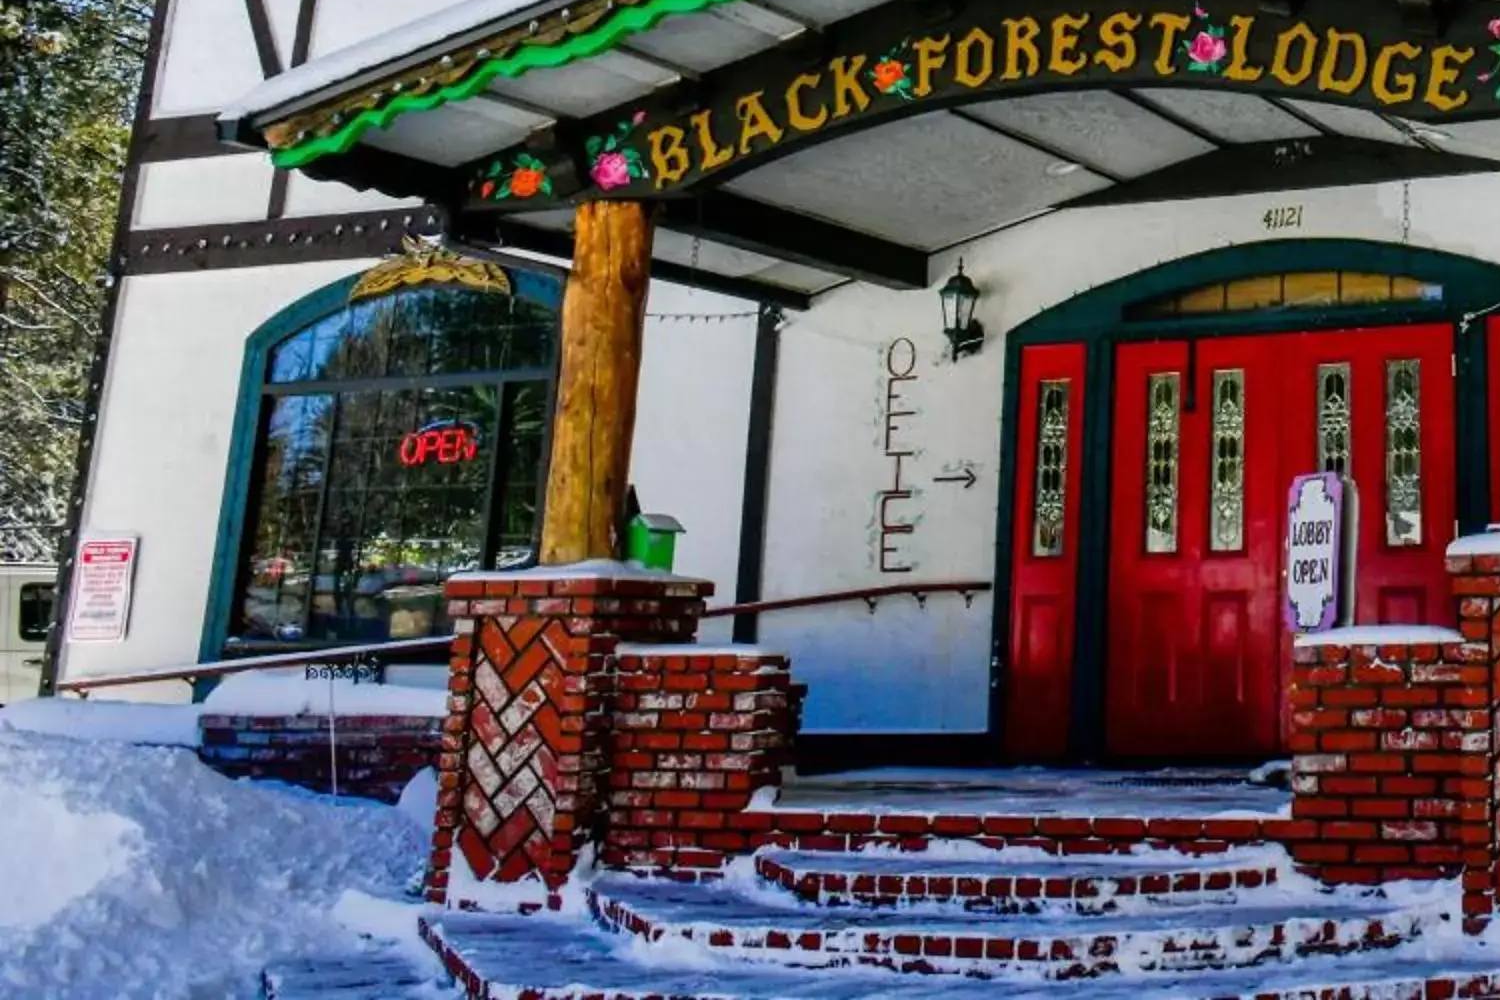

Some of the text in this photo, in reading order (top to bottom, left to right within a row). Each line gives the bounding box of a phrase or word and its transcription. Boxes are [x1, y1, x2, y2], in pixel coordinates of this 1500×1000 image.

[647, 11, 1475, 190] BLACK FOREST LODGE
[1263, 205, 1303, 230] 41121
[400, 427, 479, 467] OPEN
[880, 336, 918, 572] OFFICE
[1292, 519, 1333, 546] LOBBY
[1293, 557, 1329, 585] OPEN
